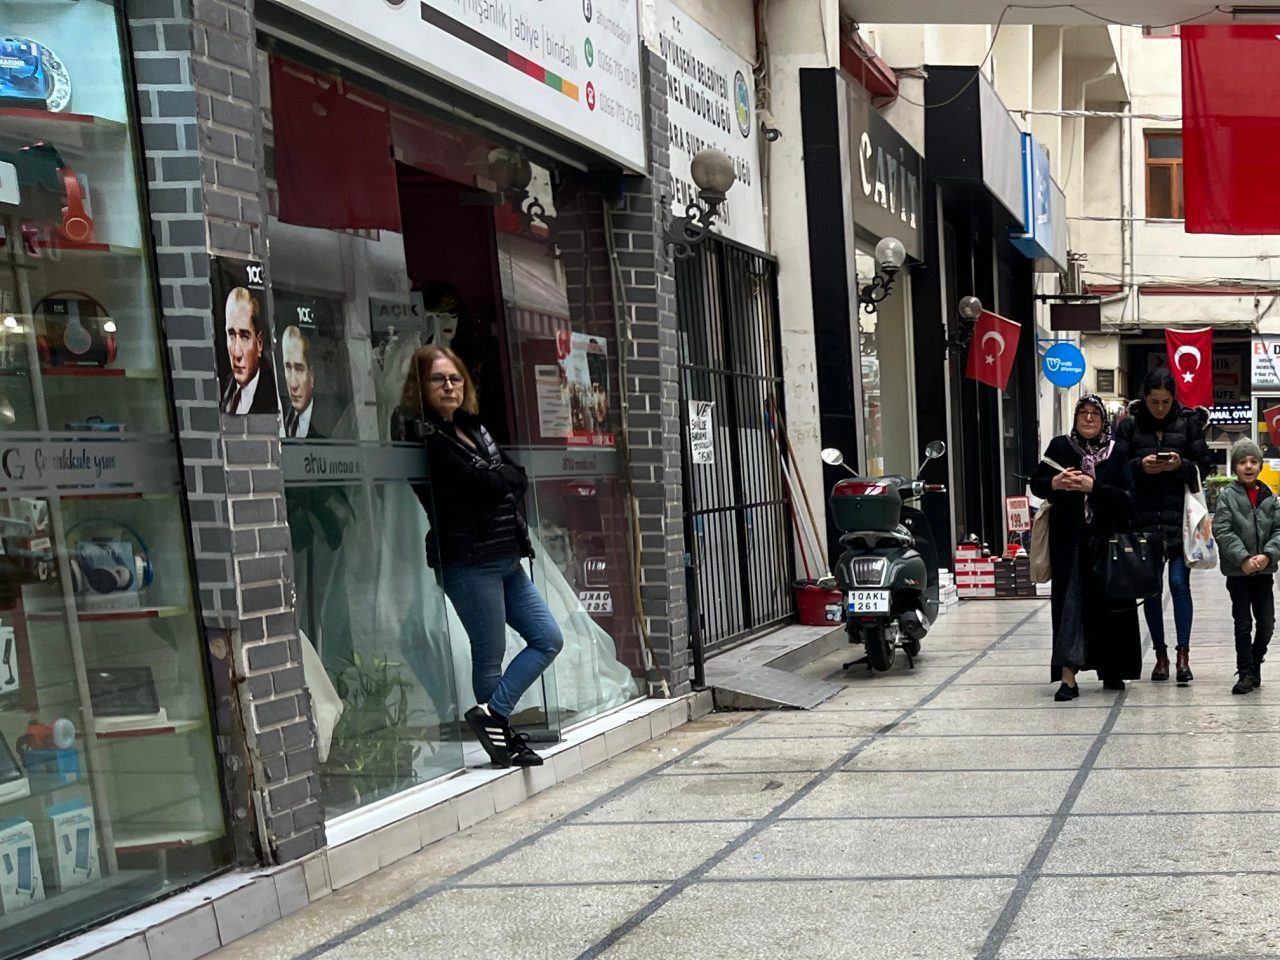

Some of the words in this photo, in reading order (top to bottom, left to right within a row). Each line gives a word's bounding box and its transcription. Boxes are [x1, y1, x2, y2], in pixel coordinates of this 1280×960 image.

[515, 15, 539, 51] abiye
[659, 30, 697, 81] BÜYÜKŞEHİR
[697, 60, 729, 101] BELEDİYESİ
[685, 83, 731, 134] MÜDÜRLÜĞÜ
[859, 131, 917, 229] CAVİT
[1254, 342, 1271, 356] EV
[857, 602, 878, 610] 261
